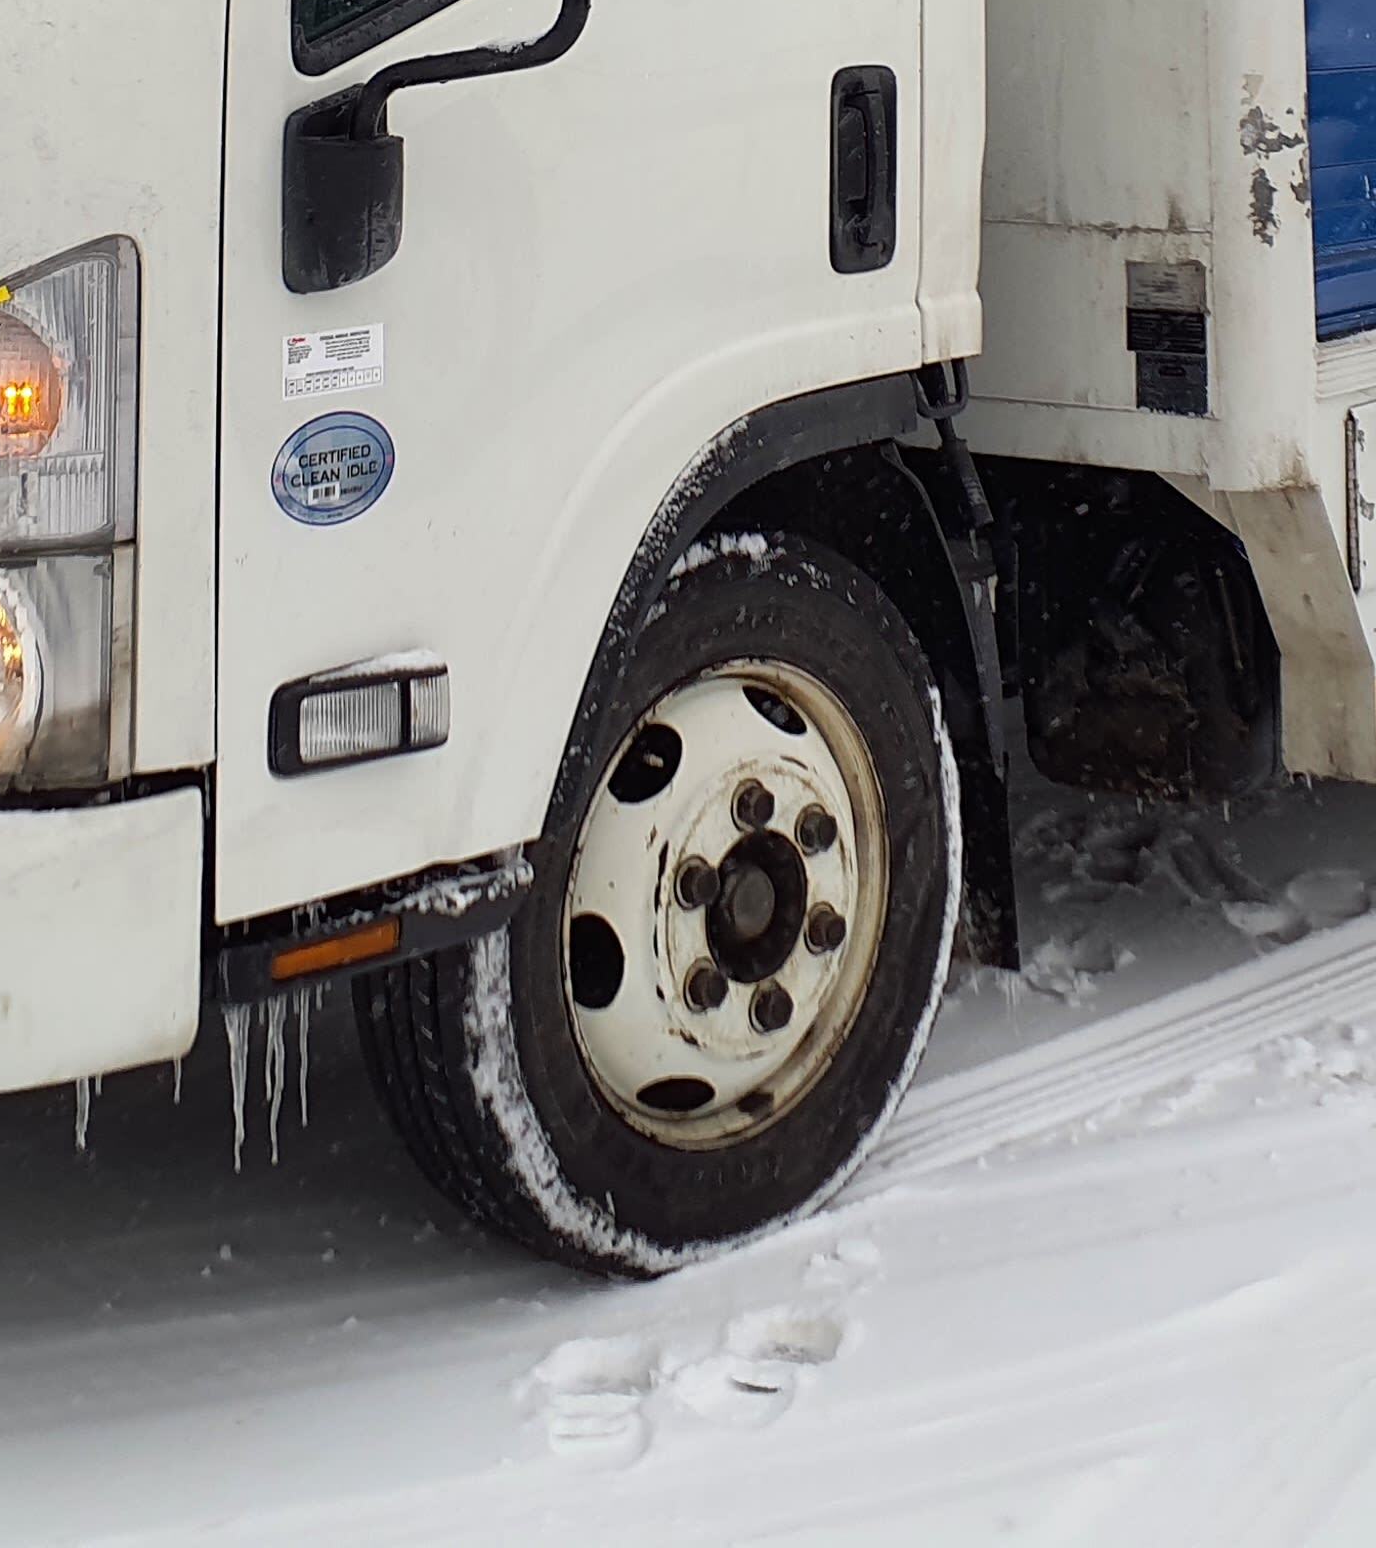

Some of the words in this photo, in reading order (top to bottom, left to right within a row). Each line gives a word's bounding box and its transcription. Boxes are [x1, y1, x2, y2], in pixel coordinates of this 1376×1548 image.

[298, 443, 371, 469] CERTIFIED
[290, 467, 341, 488] CLEAN
[347, 460, 378, 479] IDLE
